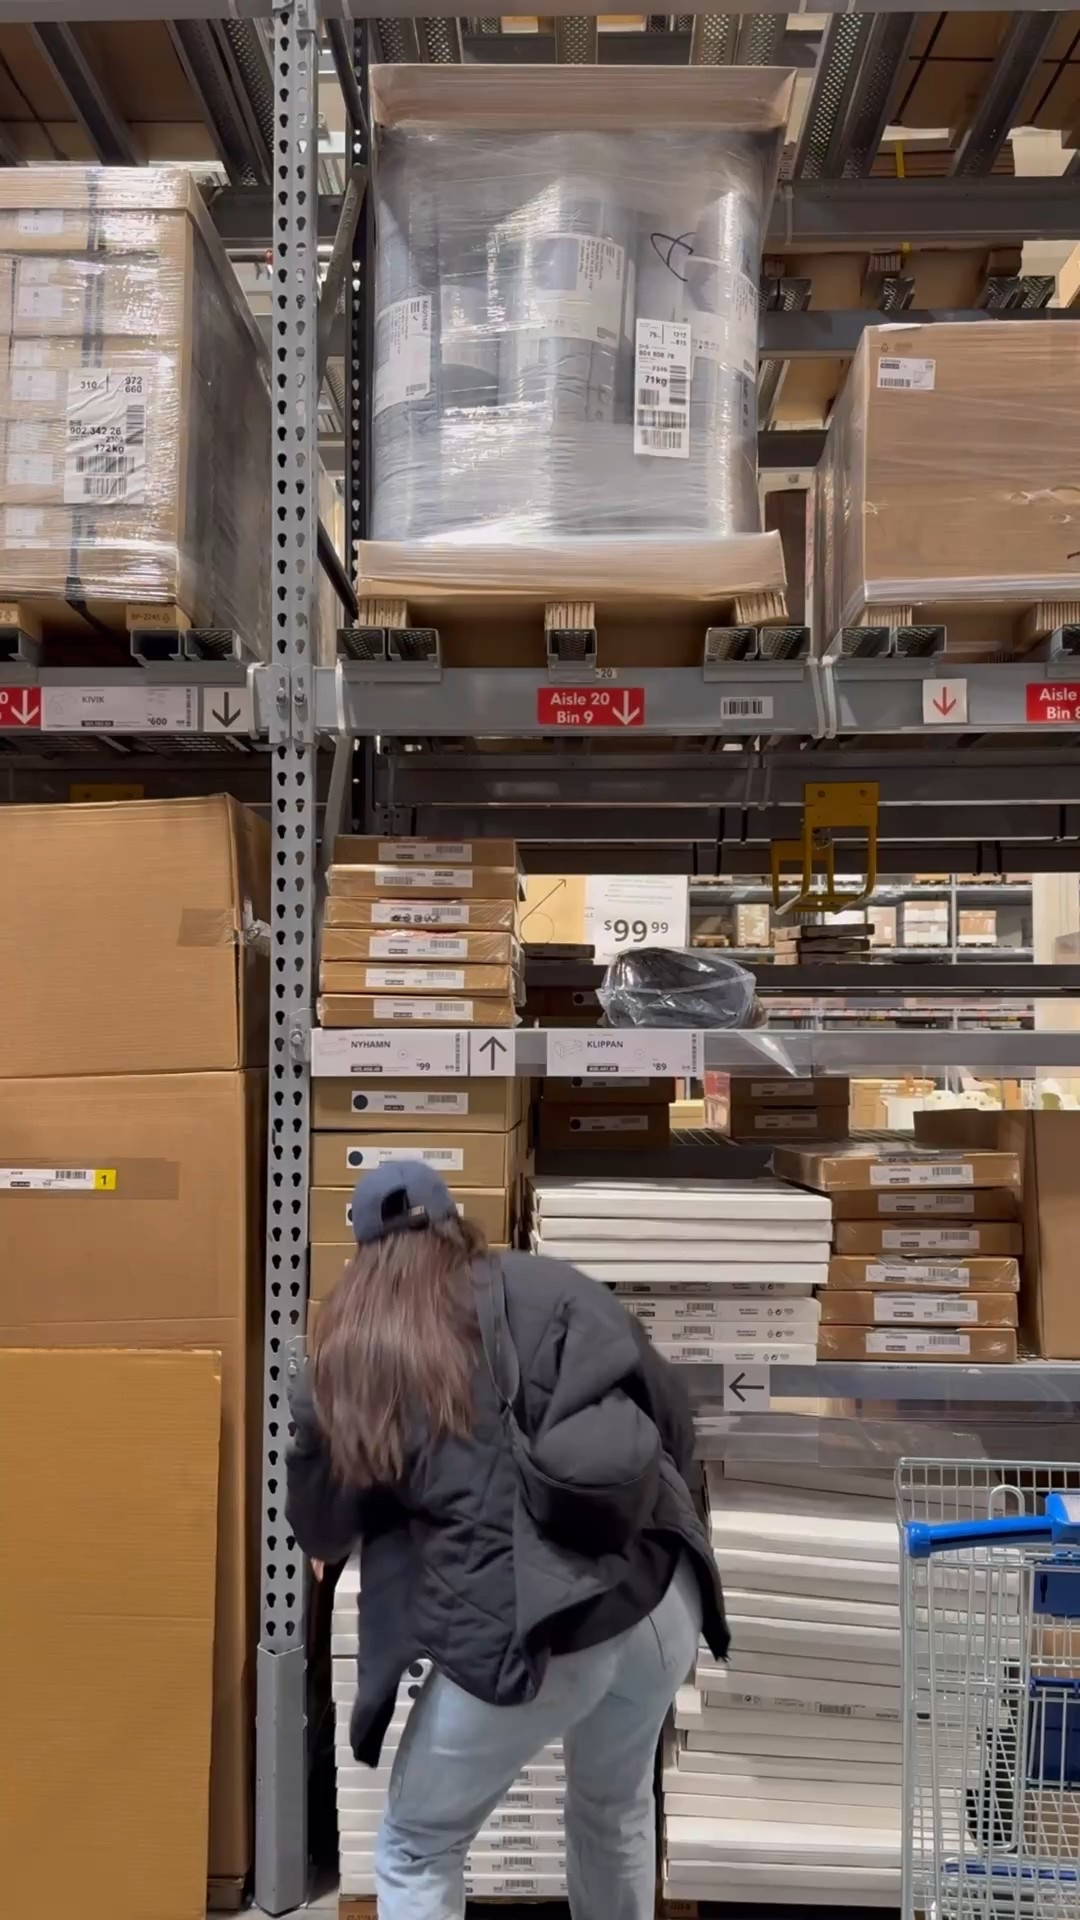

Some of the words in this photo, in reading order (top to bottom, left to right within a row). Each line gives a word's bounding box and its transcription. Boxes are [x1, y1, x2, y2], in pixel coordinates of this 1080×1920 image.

[80, 381, 98, 389] 310
[124, 376, 143, 385] 972
[645, 375, 667, 388] 71kg
[124, 385, 143, 393] 660
[89, 426, 107, 435] 342
[110, 426, 122, 435] 26
[94, 444, 125, 454] 172kg
[550, 692, 587, 705] Aisle
[590, 692, 610, 705] 20
[1039, 687, 1078, 701] Aisle
[82, 695, 105, 704] KIVIK
[556, 710, 580, 723] Bin
[583, 710, 594, 724] 9
[1047, 706, 1071, 719] Bin
[351, 1040, 391, 1049] NYHAMN
[586, 1040, 624, 1048] KLIPPAN
[100, 1174, 107, 1185] 1
